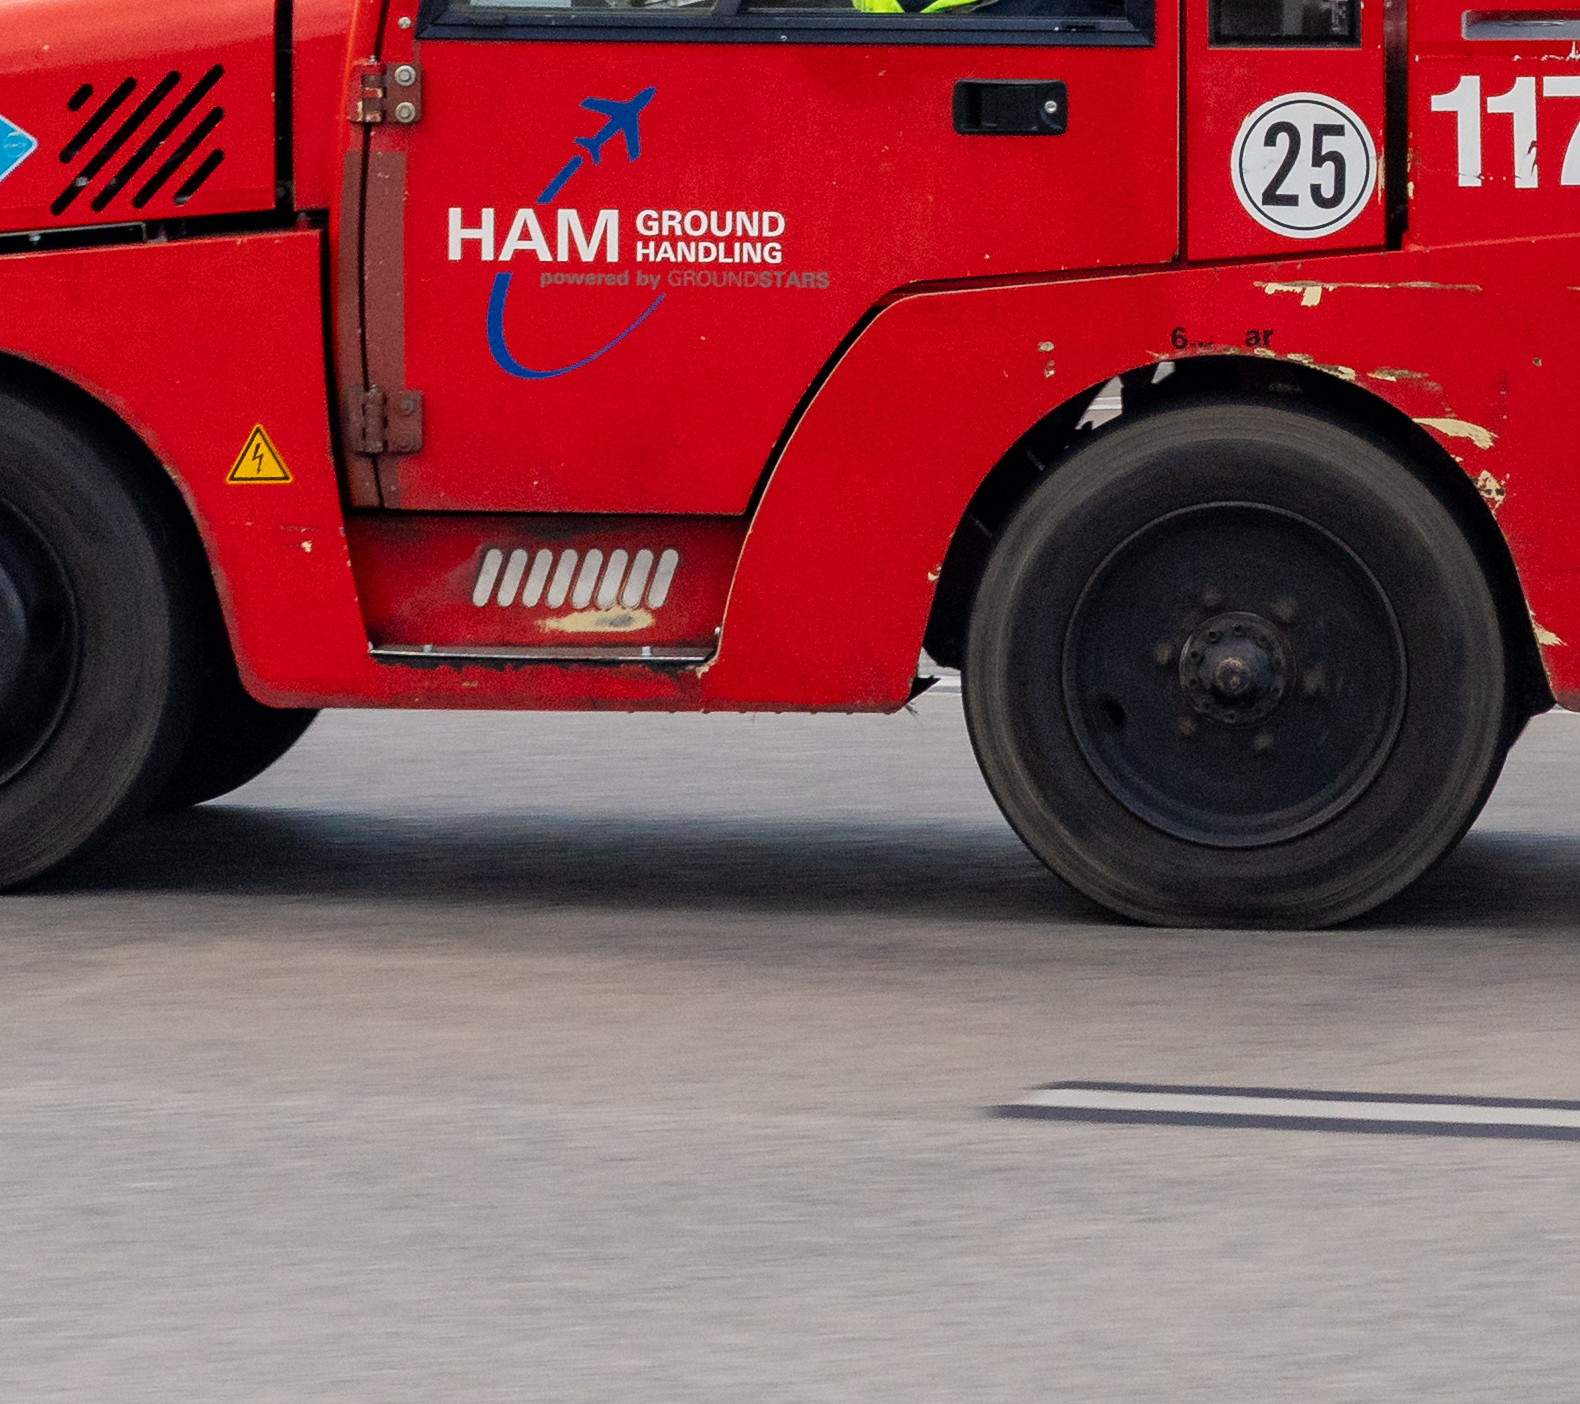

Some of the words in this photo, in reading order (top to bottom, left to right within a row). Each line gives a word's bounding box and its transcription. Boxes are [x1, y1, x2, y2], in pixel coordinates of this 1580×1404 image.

[1260, 120, 1348, 210] 25
[447, 207, 620, 263] HAM
[635, 209, 786, 237] GROUND
[635, 240, 784, 264] HANDLING
[540, 270, 630, 287] powered
[637, 270, 661, 289] by
[667, 270, 831, 289] GROUNDSTARS
